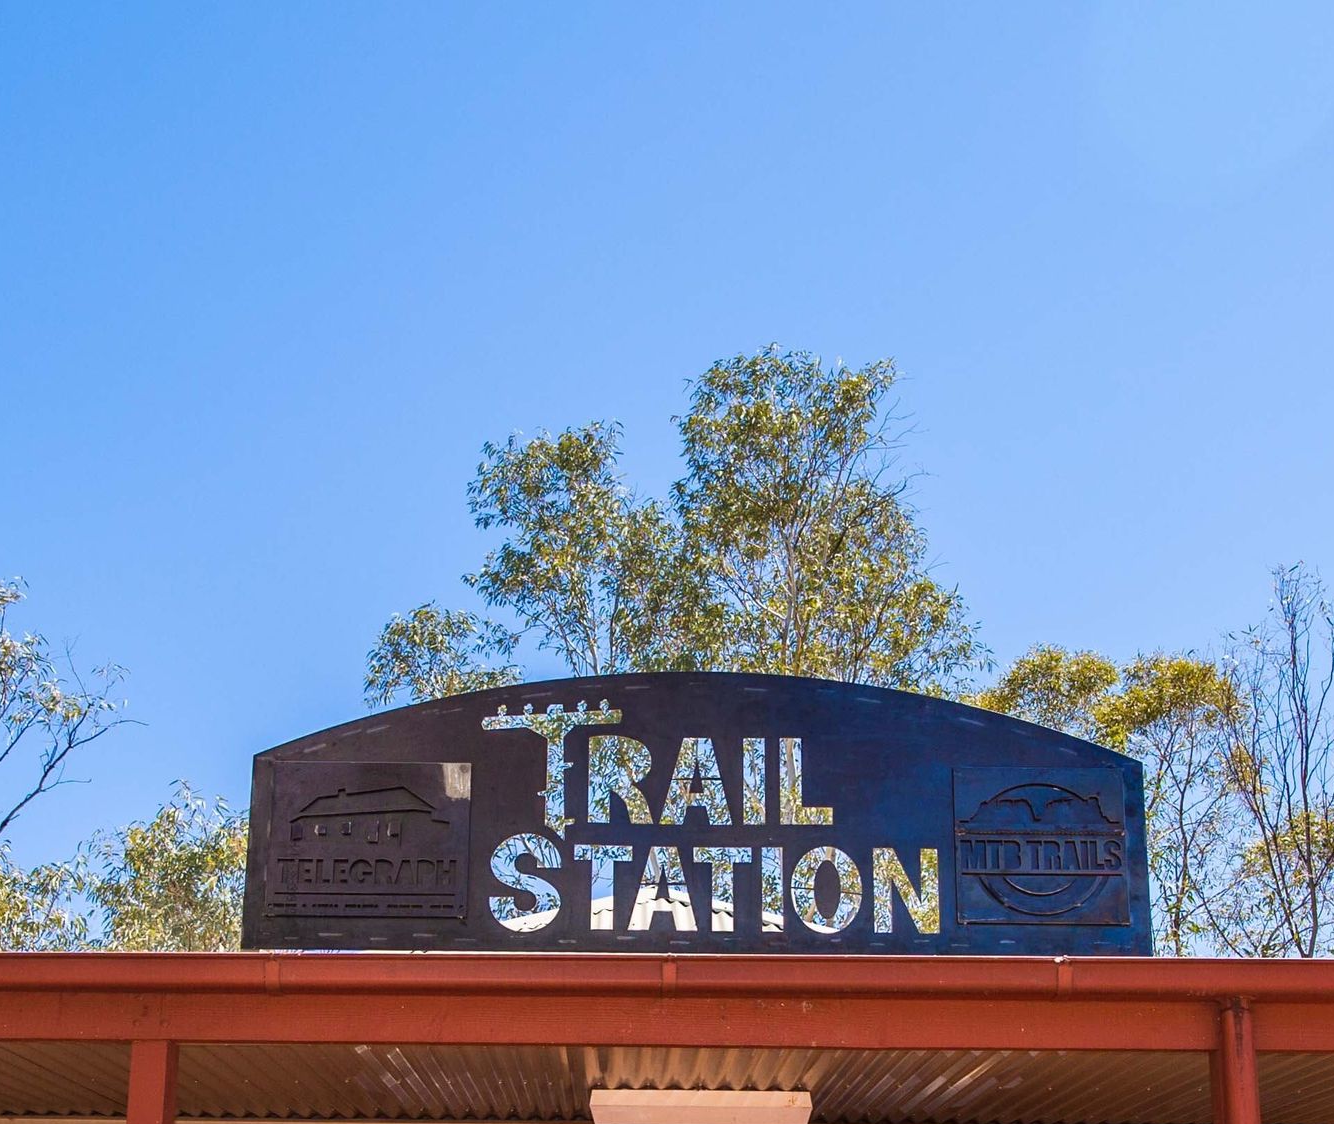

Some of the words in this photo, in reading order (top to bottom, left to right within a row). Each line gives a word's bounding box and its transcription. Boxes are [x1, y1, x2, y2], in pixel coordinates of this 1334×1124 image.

[481, 699, 834, 841] TRAIL
[276, 858, 457, 885] TELEGRAPH
[488, 832, 941, 934] STATION
[958, 839, 1022, 871] MTB
[1025, 839, 1123, 871] TRAILS
